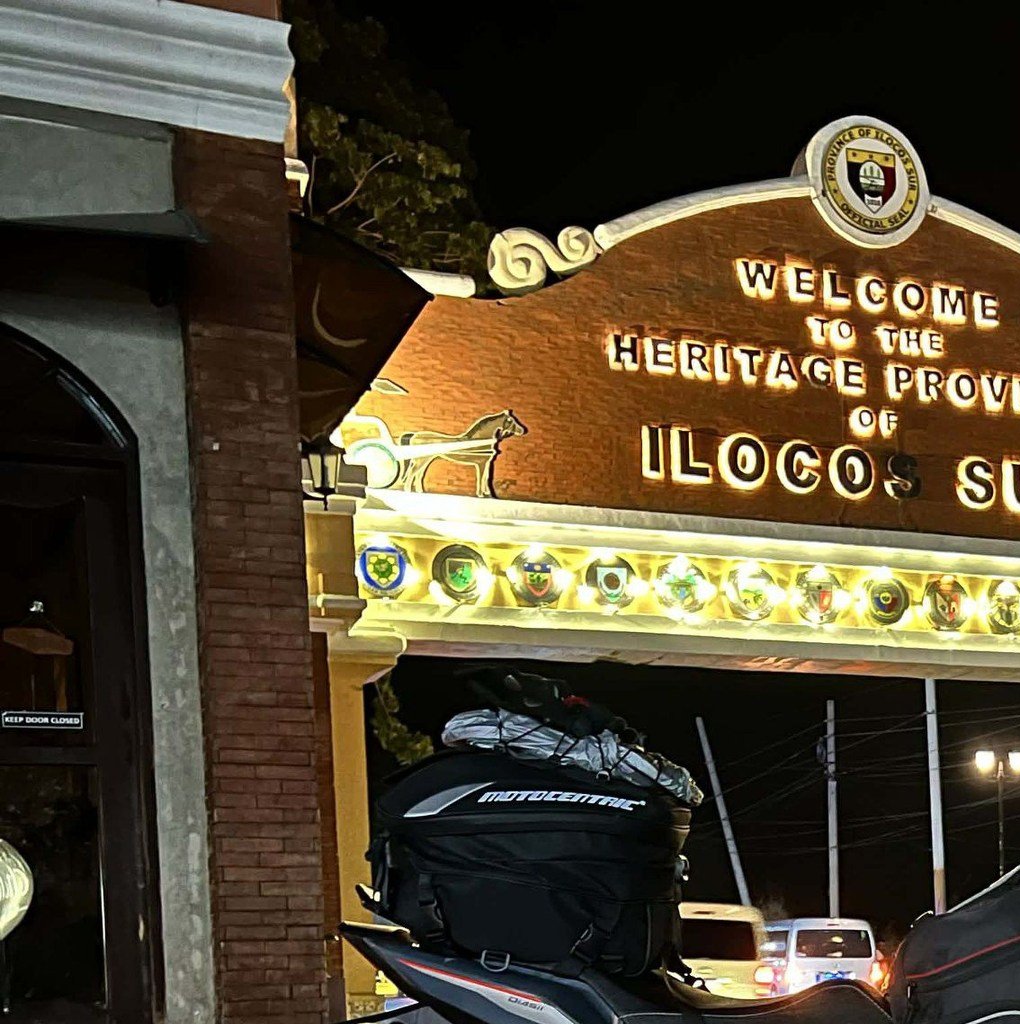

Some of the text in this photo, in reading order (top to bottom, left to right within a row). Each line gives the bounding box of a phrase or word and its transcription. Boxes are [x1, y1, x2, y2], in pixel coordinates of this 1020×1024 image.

[826, 128, 917, 191] PROVINCE OF ILOCOS SUR
[841, 203, 909, 228] OFFICIAL SEAL
[737, 259, 999, 325] WELCOME
[812, 318, 943, 355] TO THE
[609, 334, 865, 393] HERITAGE
[852, 407, 898, 436] OF
[642, 425, 921, 499] ILOCOS
[25, 716, 49, 724] DOOR
[477, 790, 643, 811] MOTOCENTRIC
